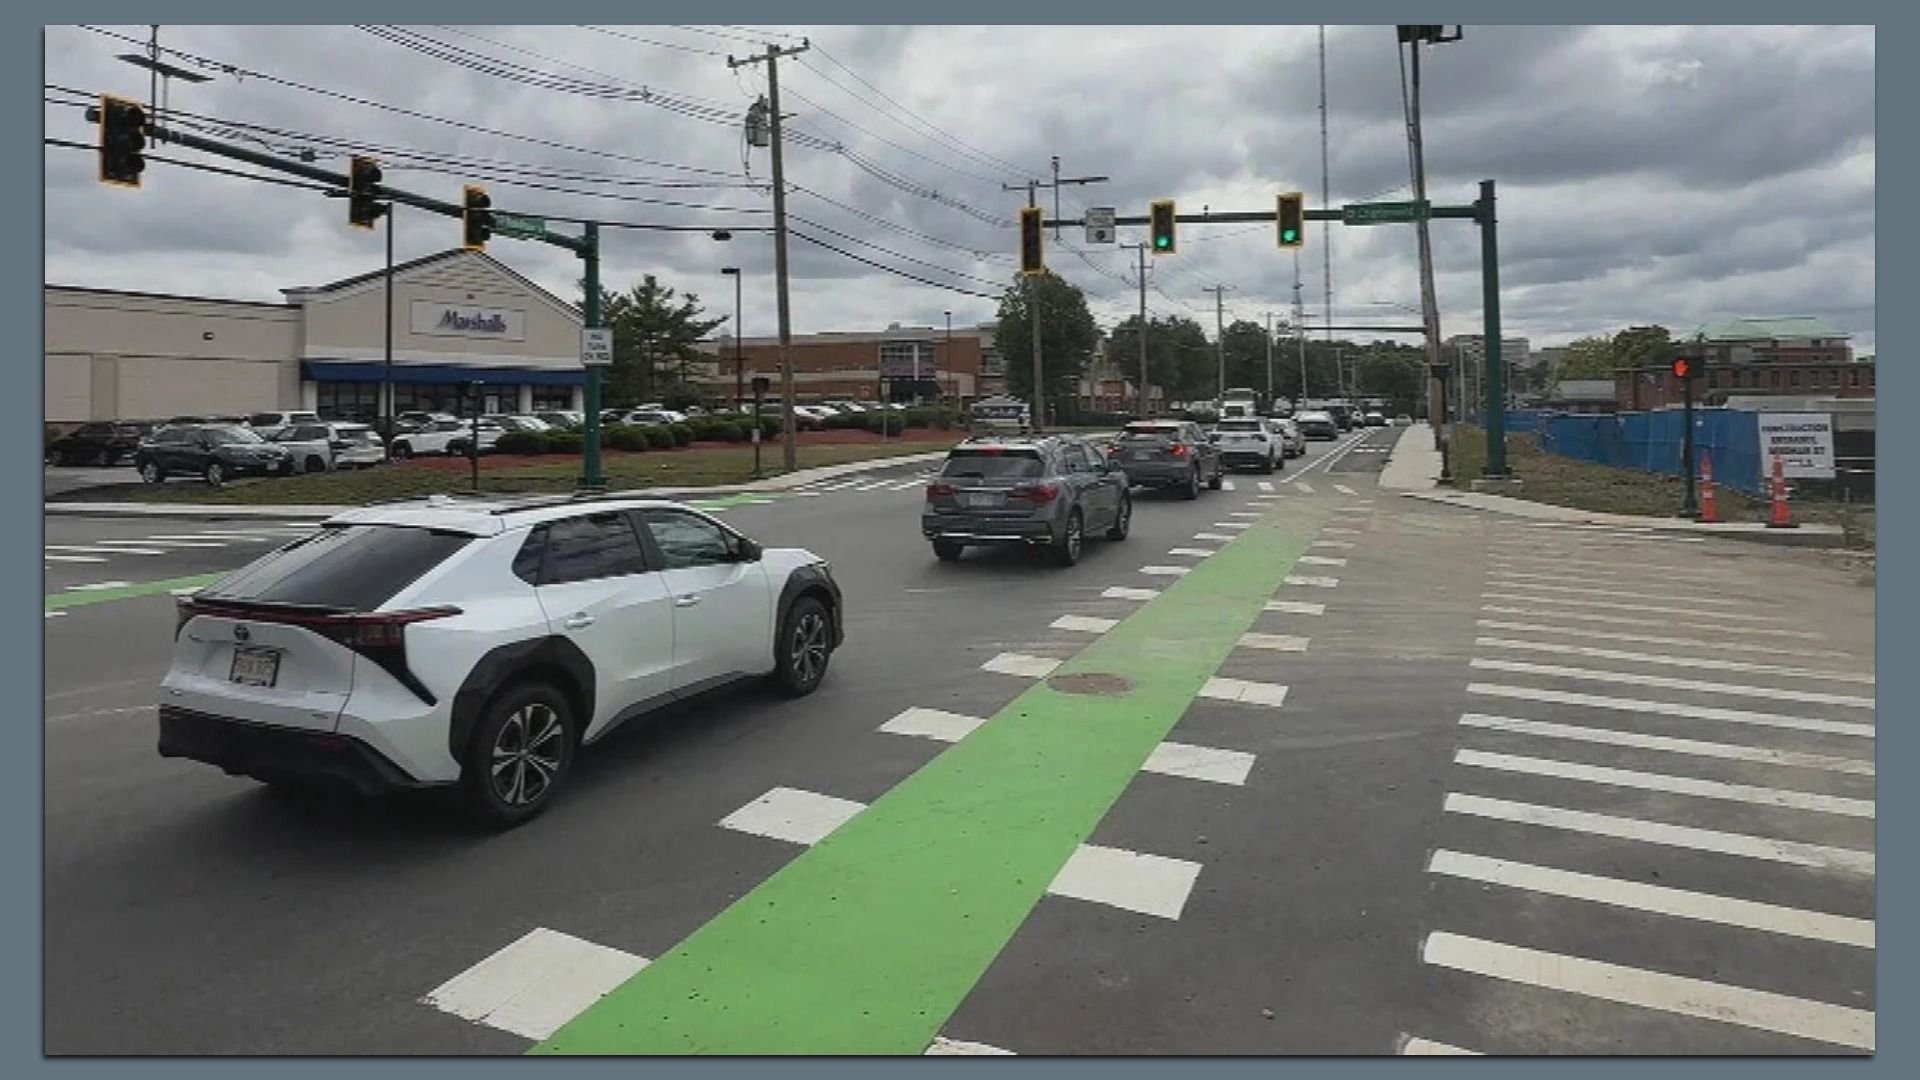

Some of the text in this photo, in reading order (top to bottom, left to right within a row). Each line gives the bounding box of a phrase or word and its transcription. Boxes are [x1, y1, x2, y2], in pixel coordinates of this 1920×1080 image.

[435, 309, 507, 332] Marshalls
[588, 342, 607, 350] TURN
[584, 352, 609, 360] ON RED
[1761, 423, 1828, 432] CONSTRUCTION
